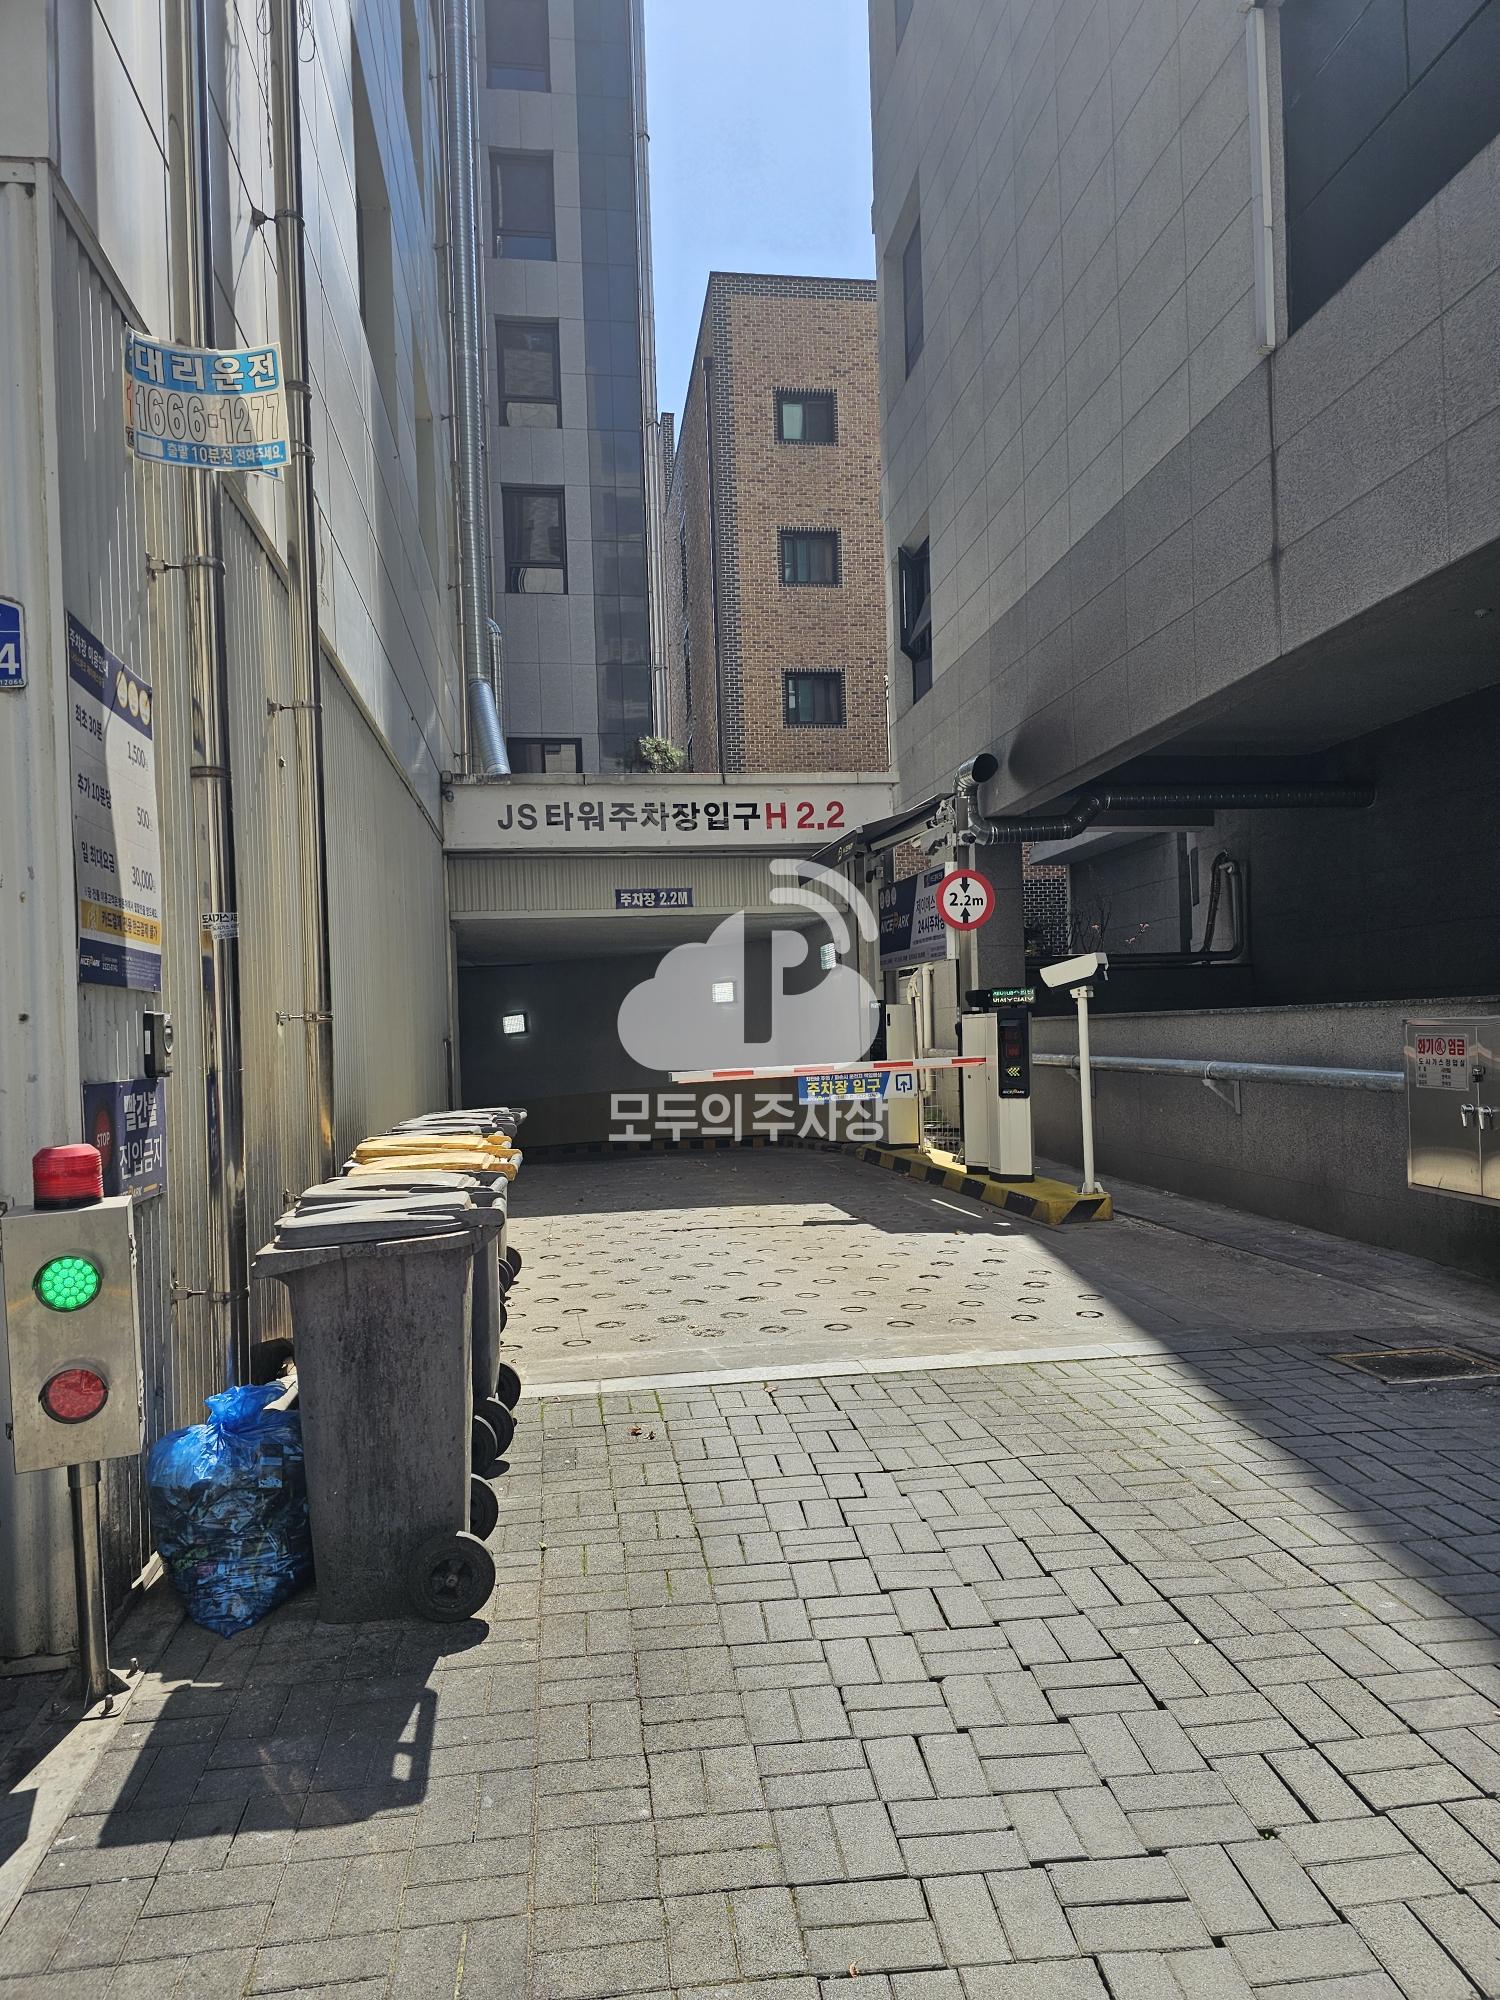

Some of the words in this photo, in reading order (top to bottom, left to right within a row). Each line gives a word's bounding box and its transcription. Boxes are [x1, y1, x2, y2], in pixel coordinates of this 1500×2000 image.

[134, 345, 276, 392] 대리운전
[135, 384, 280, 444] 1666-1277
[193, 446, 233, 465] 10분전
[75, 704, 88, 730] 최초
[89, 715, 103, 742] 30분
[77, 772, 90, 798] 추가
[620, 892, 656, 907] 주차장
[659, 890, 688, 905] 2.2M
[949, 892, 984, 906] 2.2m
[202, 914, 229, 923] 도시가스
[1418, 1038, 1433, 1055] 화기
[1448, 1039, 1465, 1055] 엄금
[807, 1080, 848, 1096] 주차장
[853, 1078, 881, 1093] 입구
[124, 1091, 157, 1132] 빨간불
[96, 1131, 111, 1148] STOP
[120, 1134, 163, 1180] 진입금지
